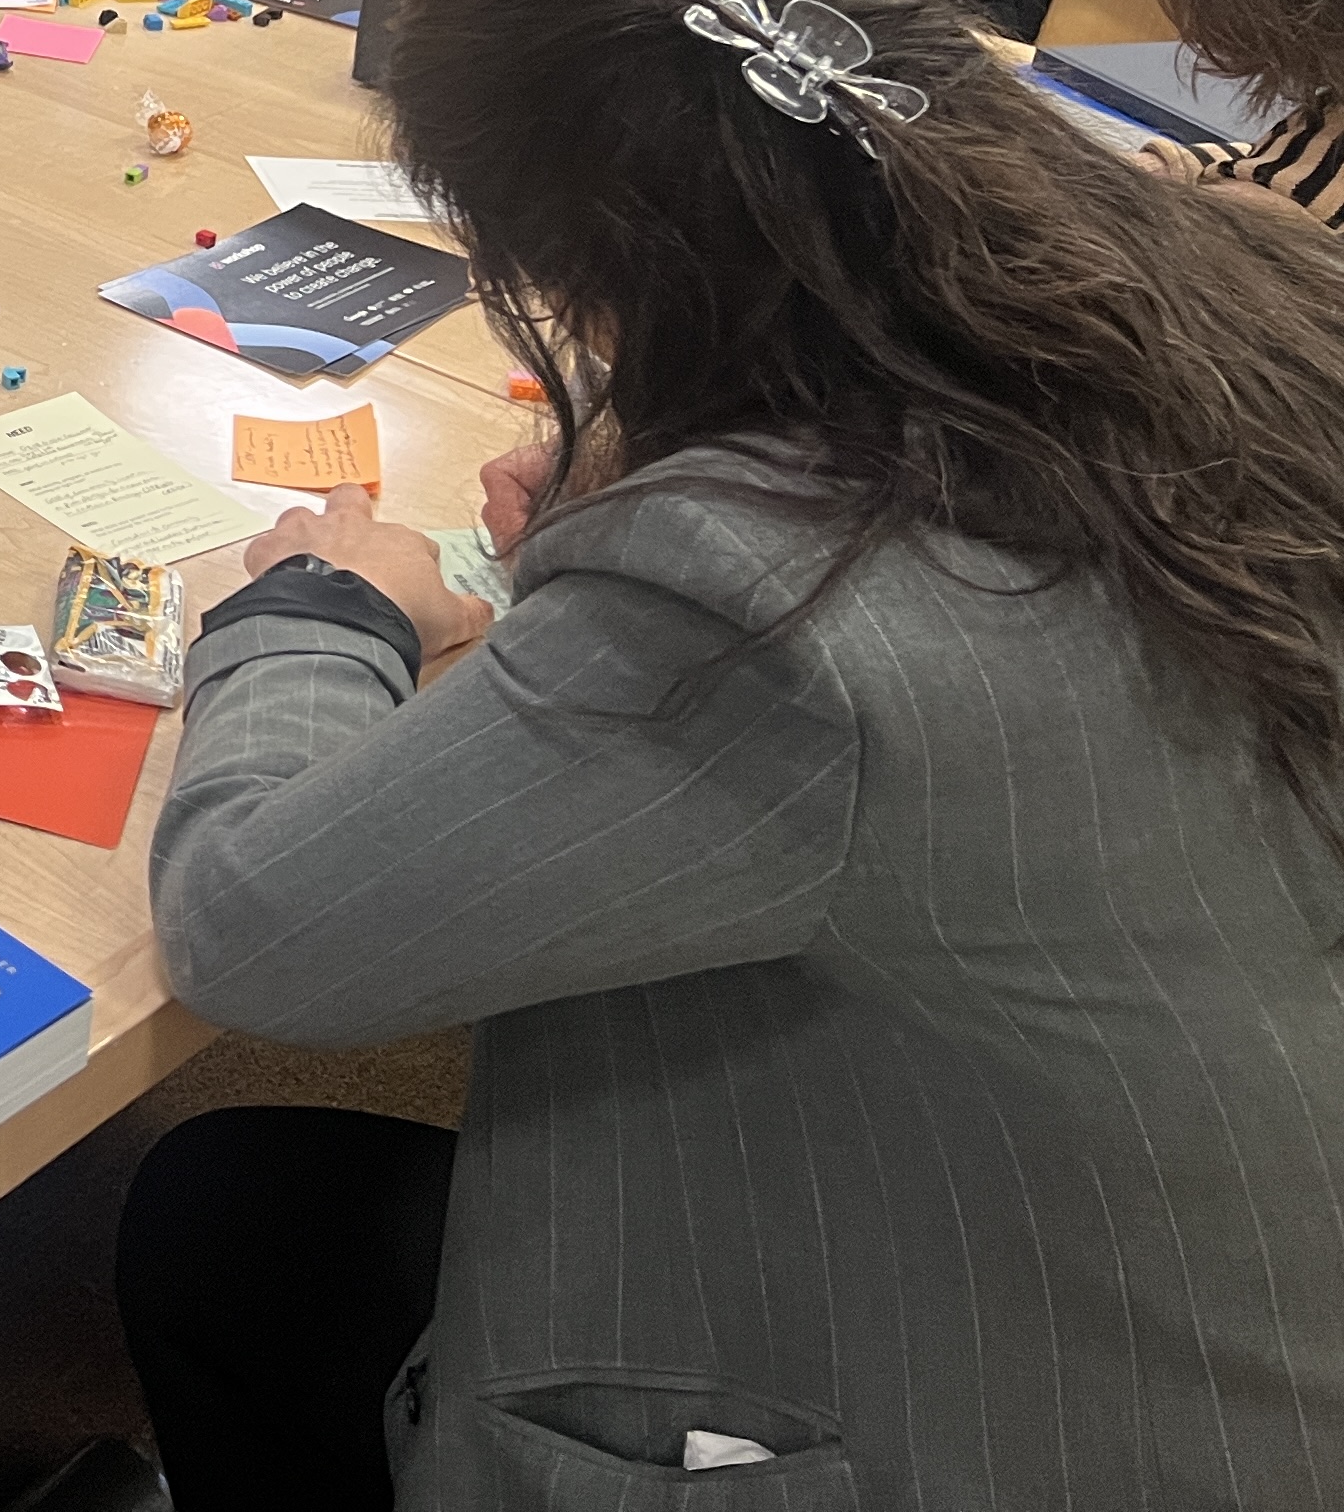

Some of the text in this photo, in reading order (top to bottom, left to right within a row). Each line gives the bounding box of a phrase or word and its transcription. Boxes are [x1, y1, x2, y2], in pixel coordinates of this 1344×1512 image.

[240, 272, 268, 284] We
[261, 255, 308, 277] believe
[313, 241, 340, 254] the
[313, 250, 355, 273] people
[298, 274, 340, 295] create
[5, 425, 34, 439] NEED
